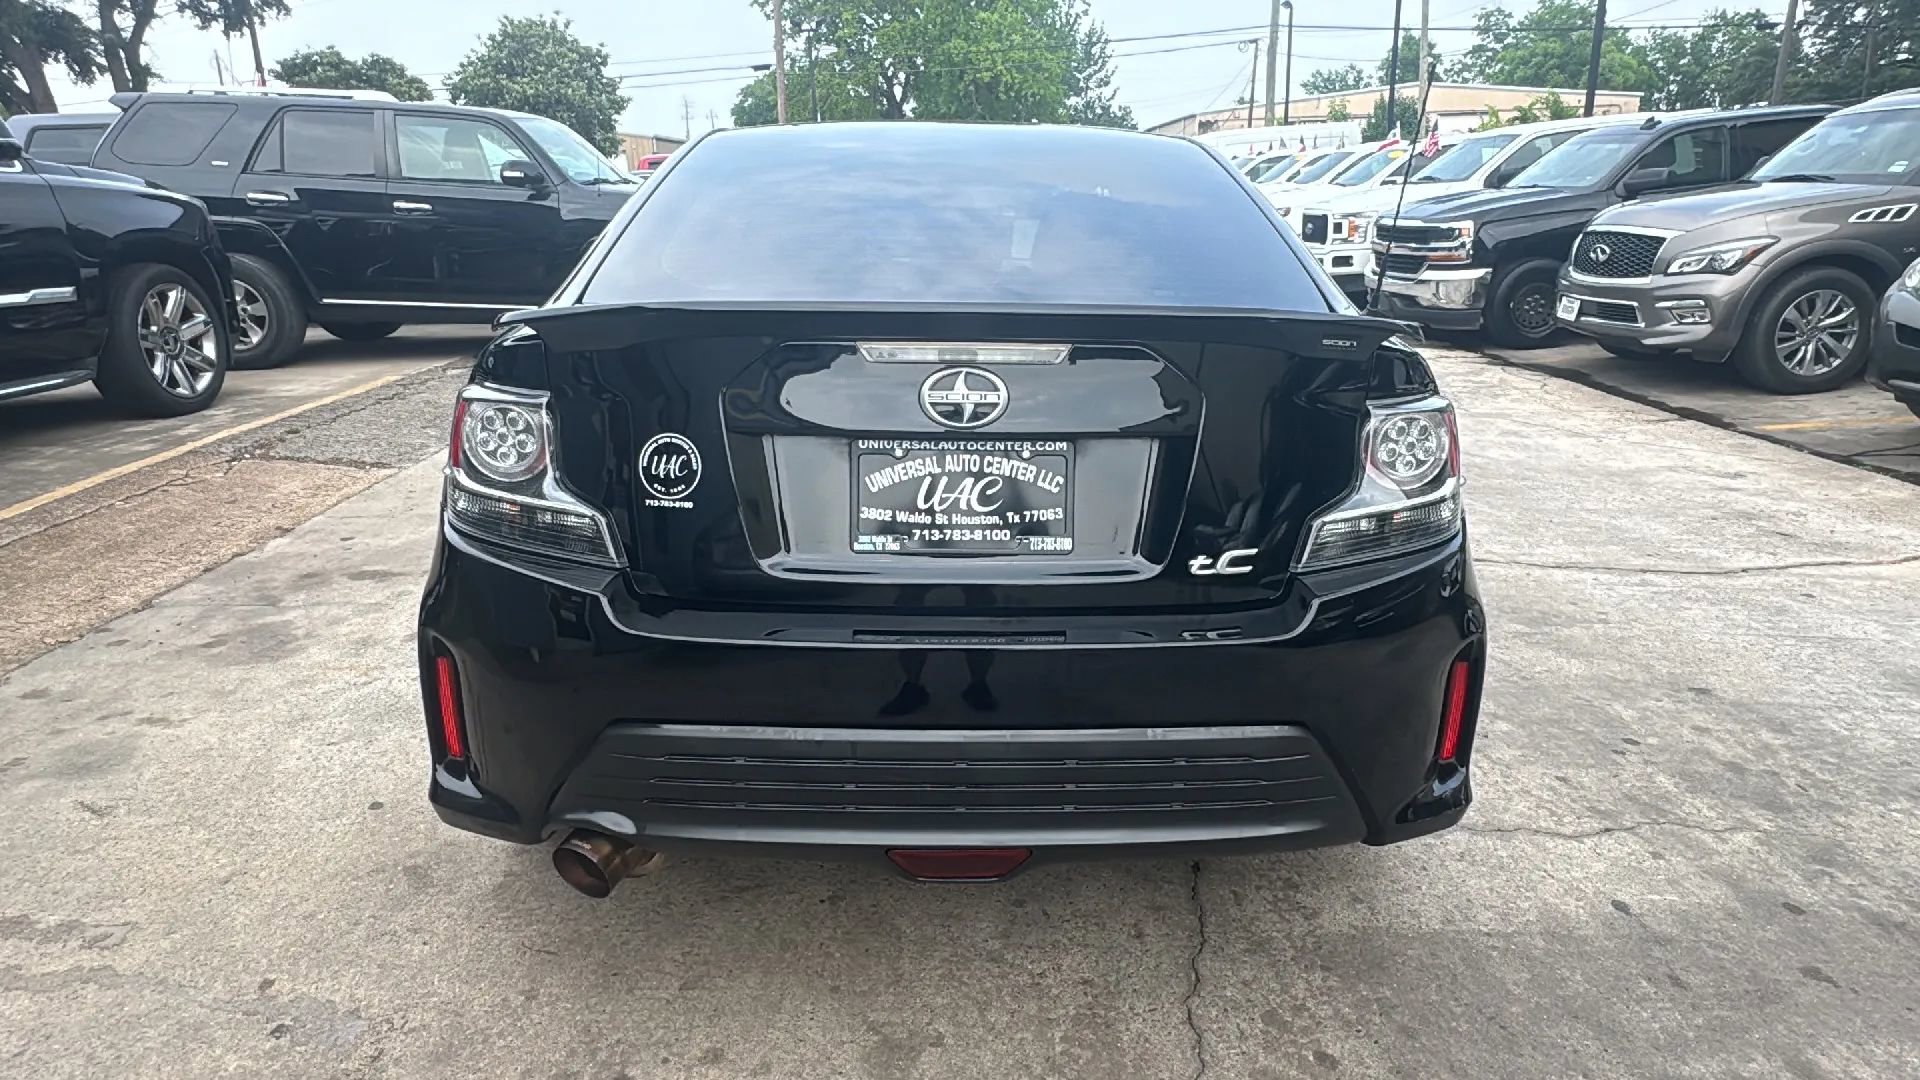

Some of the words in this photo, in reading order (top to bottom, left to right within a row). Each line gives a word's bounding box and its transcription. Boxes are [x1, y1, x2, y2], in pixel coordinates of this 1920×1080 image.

[858, 439, 1068, 452] UNIVERSALAUTOCENTER.COM
[651, 454, 688, 479] UAC
[864, 455, 942, 493] UNIVERSAL
[945, 453, 981, 473] AUTO
[983, 455, 1038, 483] CENTER
[1037, 469, 1065, 494] LLC
[916, 475, 1004, 512] UAC
[859, 506, 893, 521] 3802
[895, 509, 932, 524] Waldo
[934, 512, 949, 525] St
[951, 513, 1004, 526] Houston,
[1006, 511, 1021, 524] Tx
[1023, 507, 1064, 522] 77063
[911, 529, 1011, 541] 713-783-8100
[1188, 548, 1259, 575] tC
